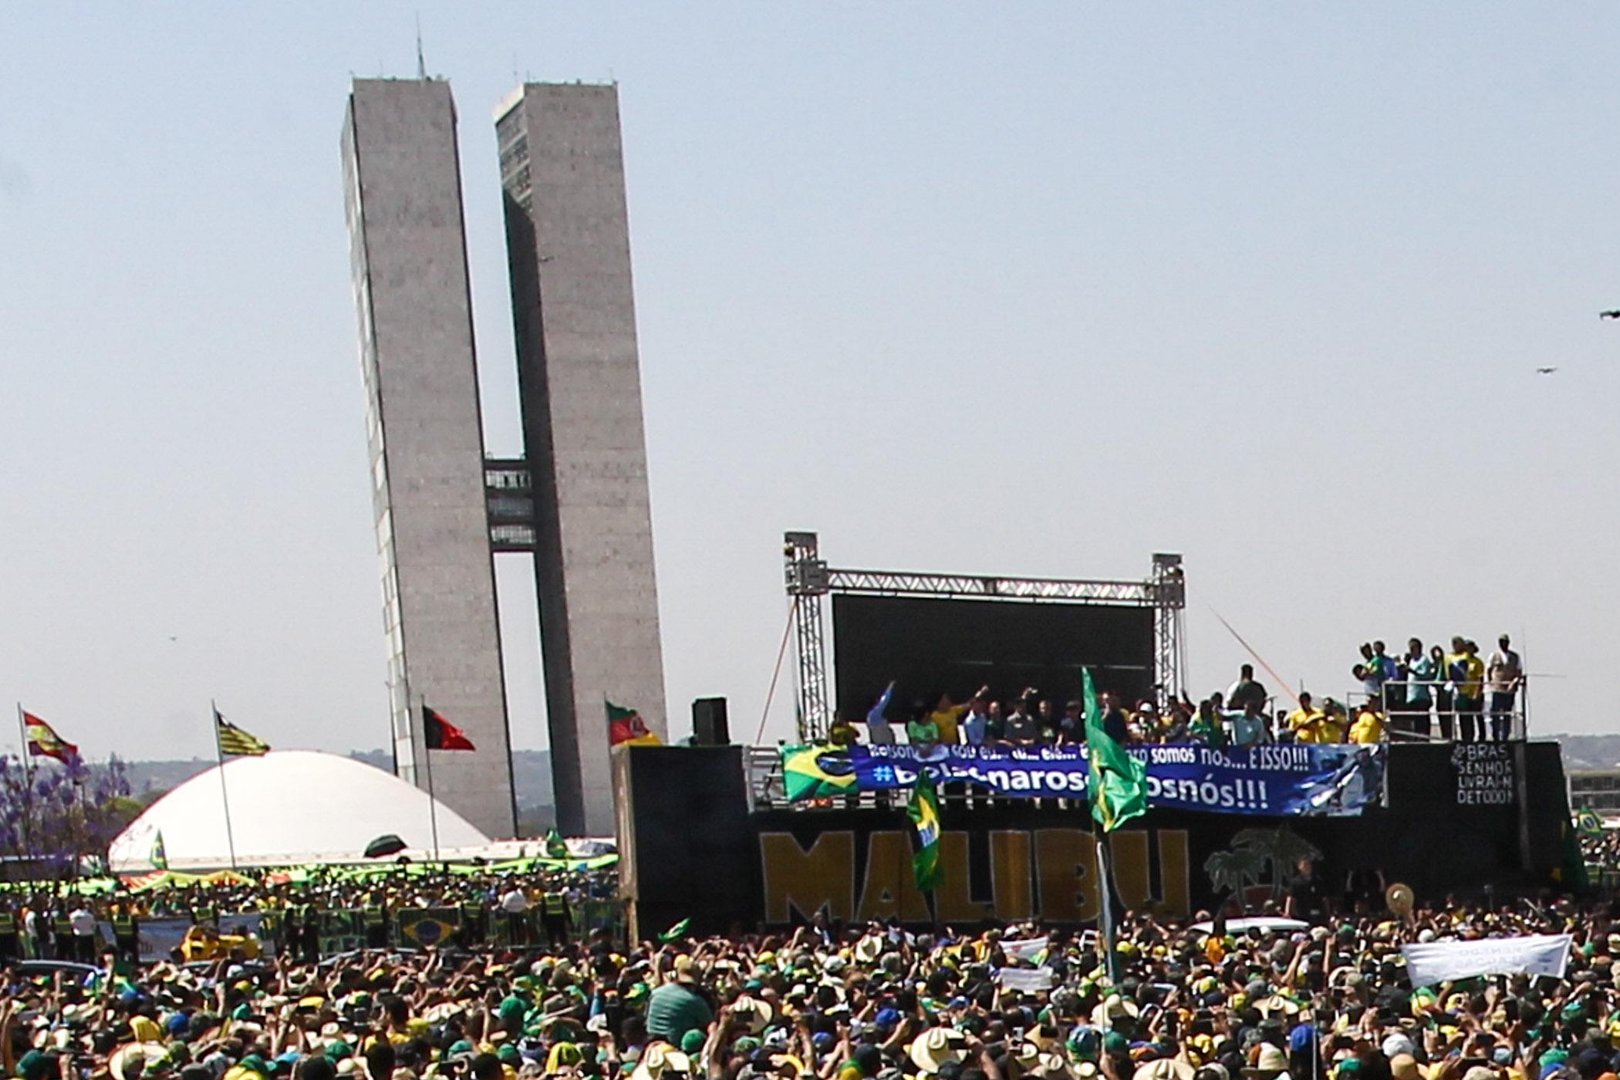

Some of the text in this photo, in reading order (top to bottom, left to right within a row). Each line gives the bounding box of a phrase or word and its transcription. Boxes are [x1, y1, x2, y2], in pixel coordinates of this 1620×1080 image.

[1151, 747, 1196, 764] somos
[1260, 745, 1310, 772] ISSO!!!
[759, 828, 1191, 924] MALIBU
